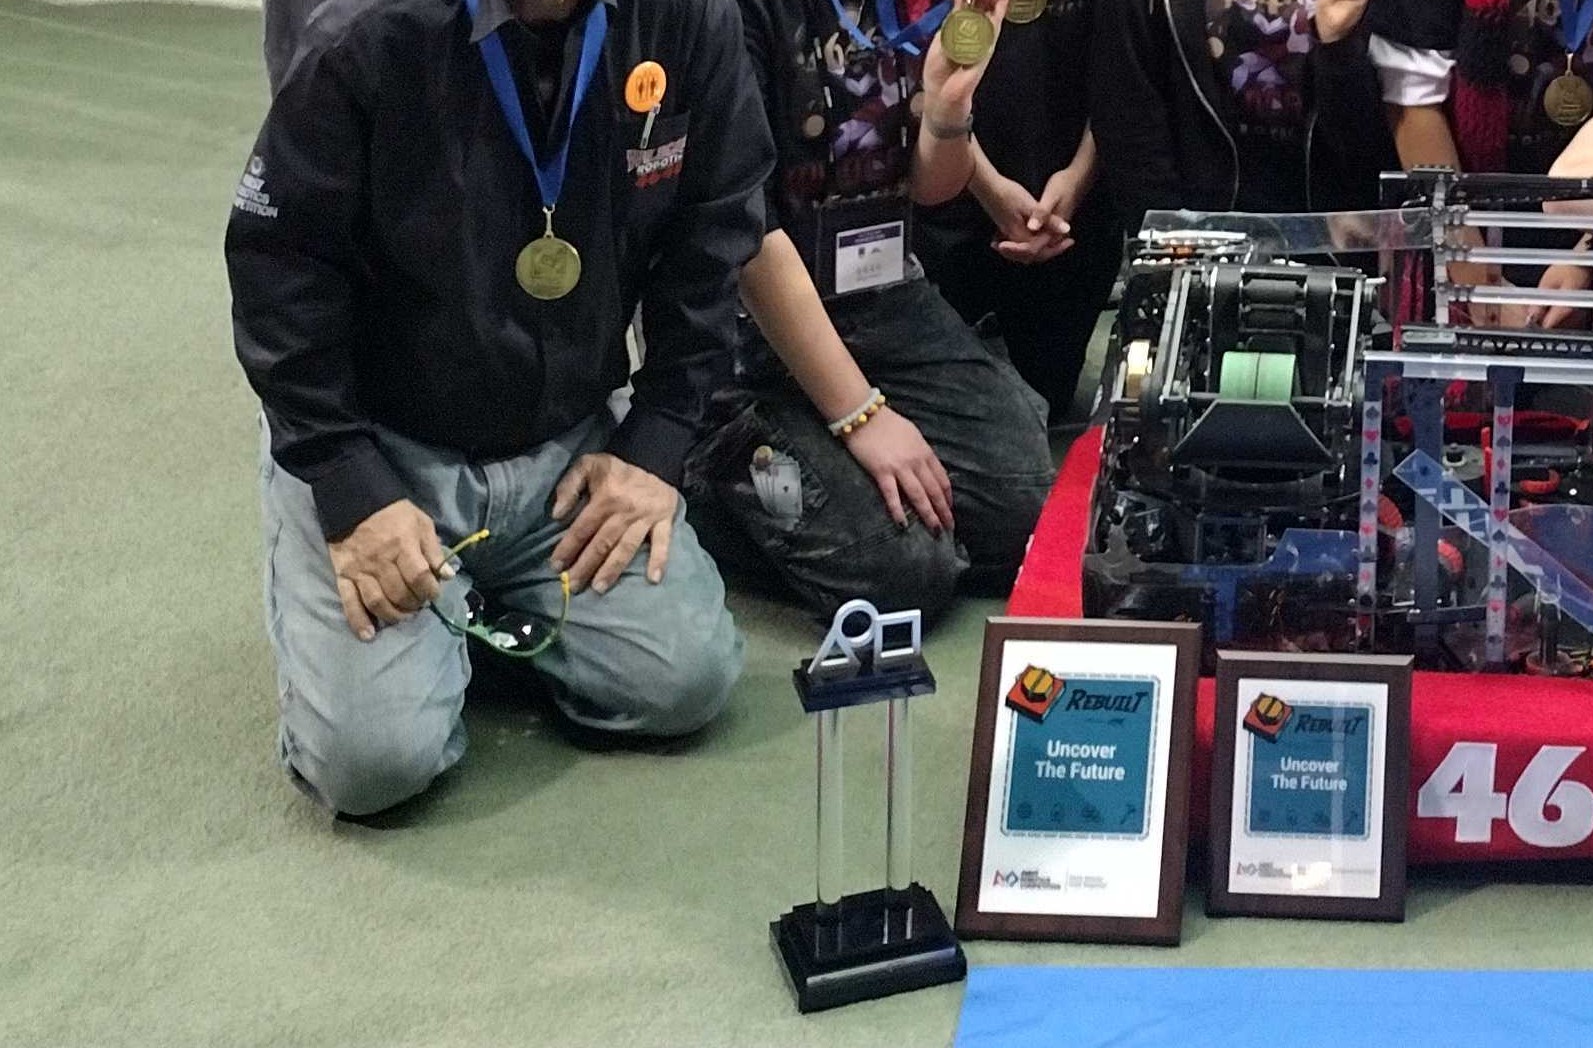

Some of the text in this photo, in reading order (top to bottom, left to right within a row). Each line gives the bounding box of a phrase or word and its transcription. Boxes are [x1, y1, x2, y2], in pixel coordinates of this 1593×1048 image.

[1047, 739, 1117, 759] Uncover
[1034, 760, 1126, 781] The Future
[1280, 755, 1340, 772] Uncover
[1270, 773, 1348, 792] The Future
